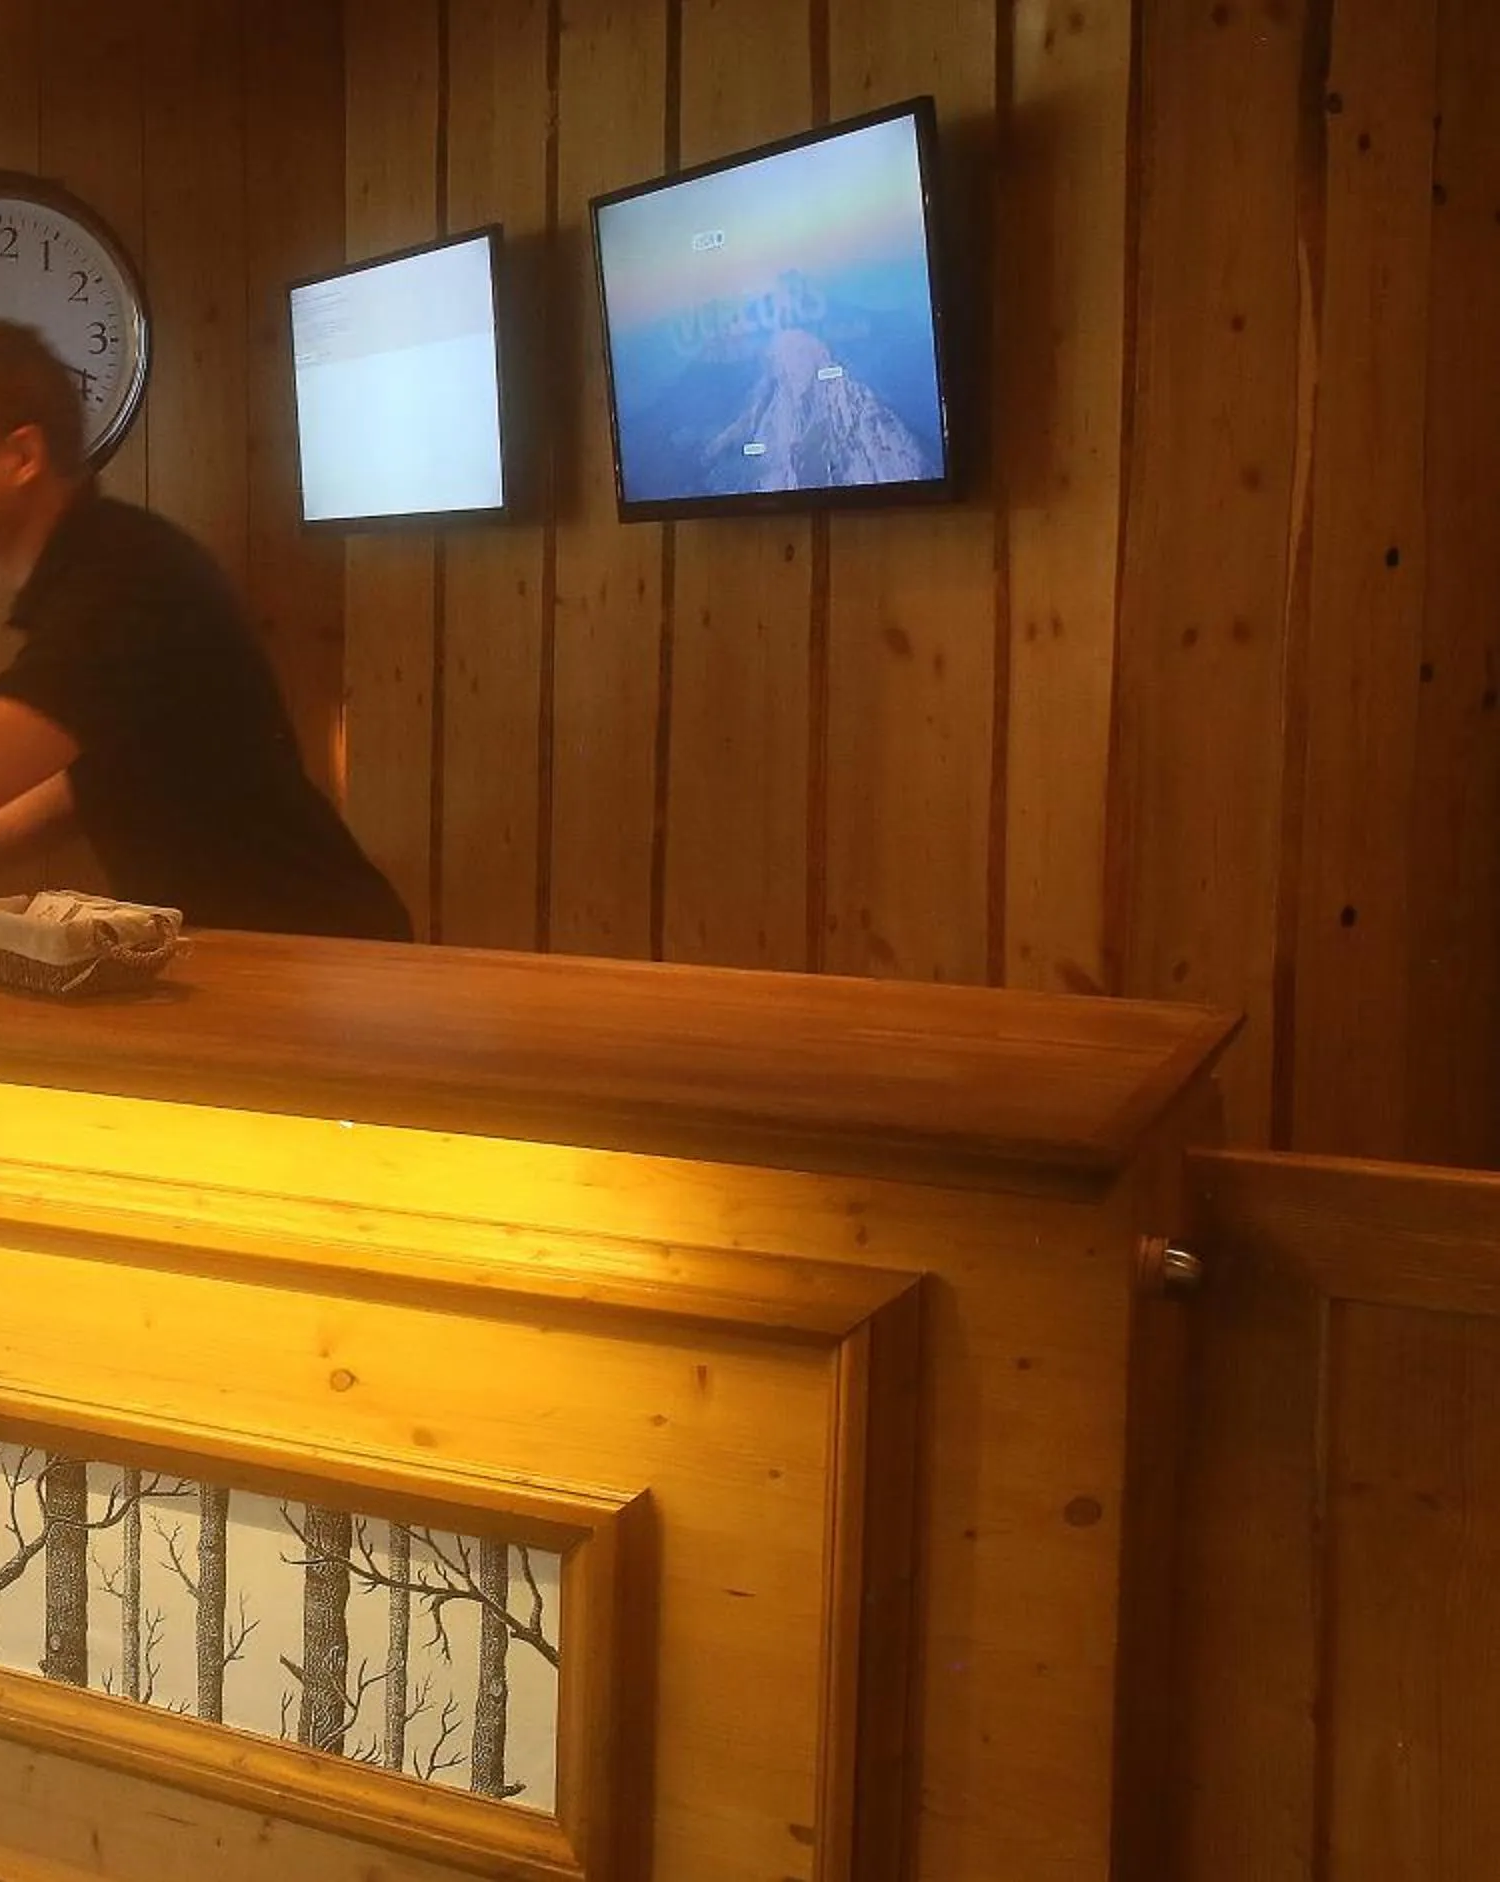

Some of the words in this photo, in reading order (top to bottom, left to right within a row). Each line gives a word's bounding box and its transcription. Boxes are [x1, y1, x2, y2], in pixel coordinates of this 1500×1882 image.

[40, 239, 53, 272] 1
[68, 271, 89, 303] 2
[86, 321, 108, 355] 3
